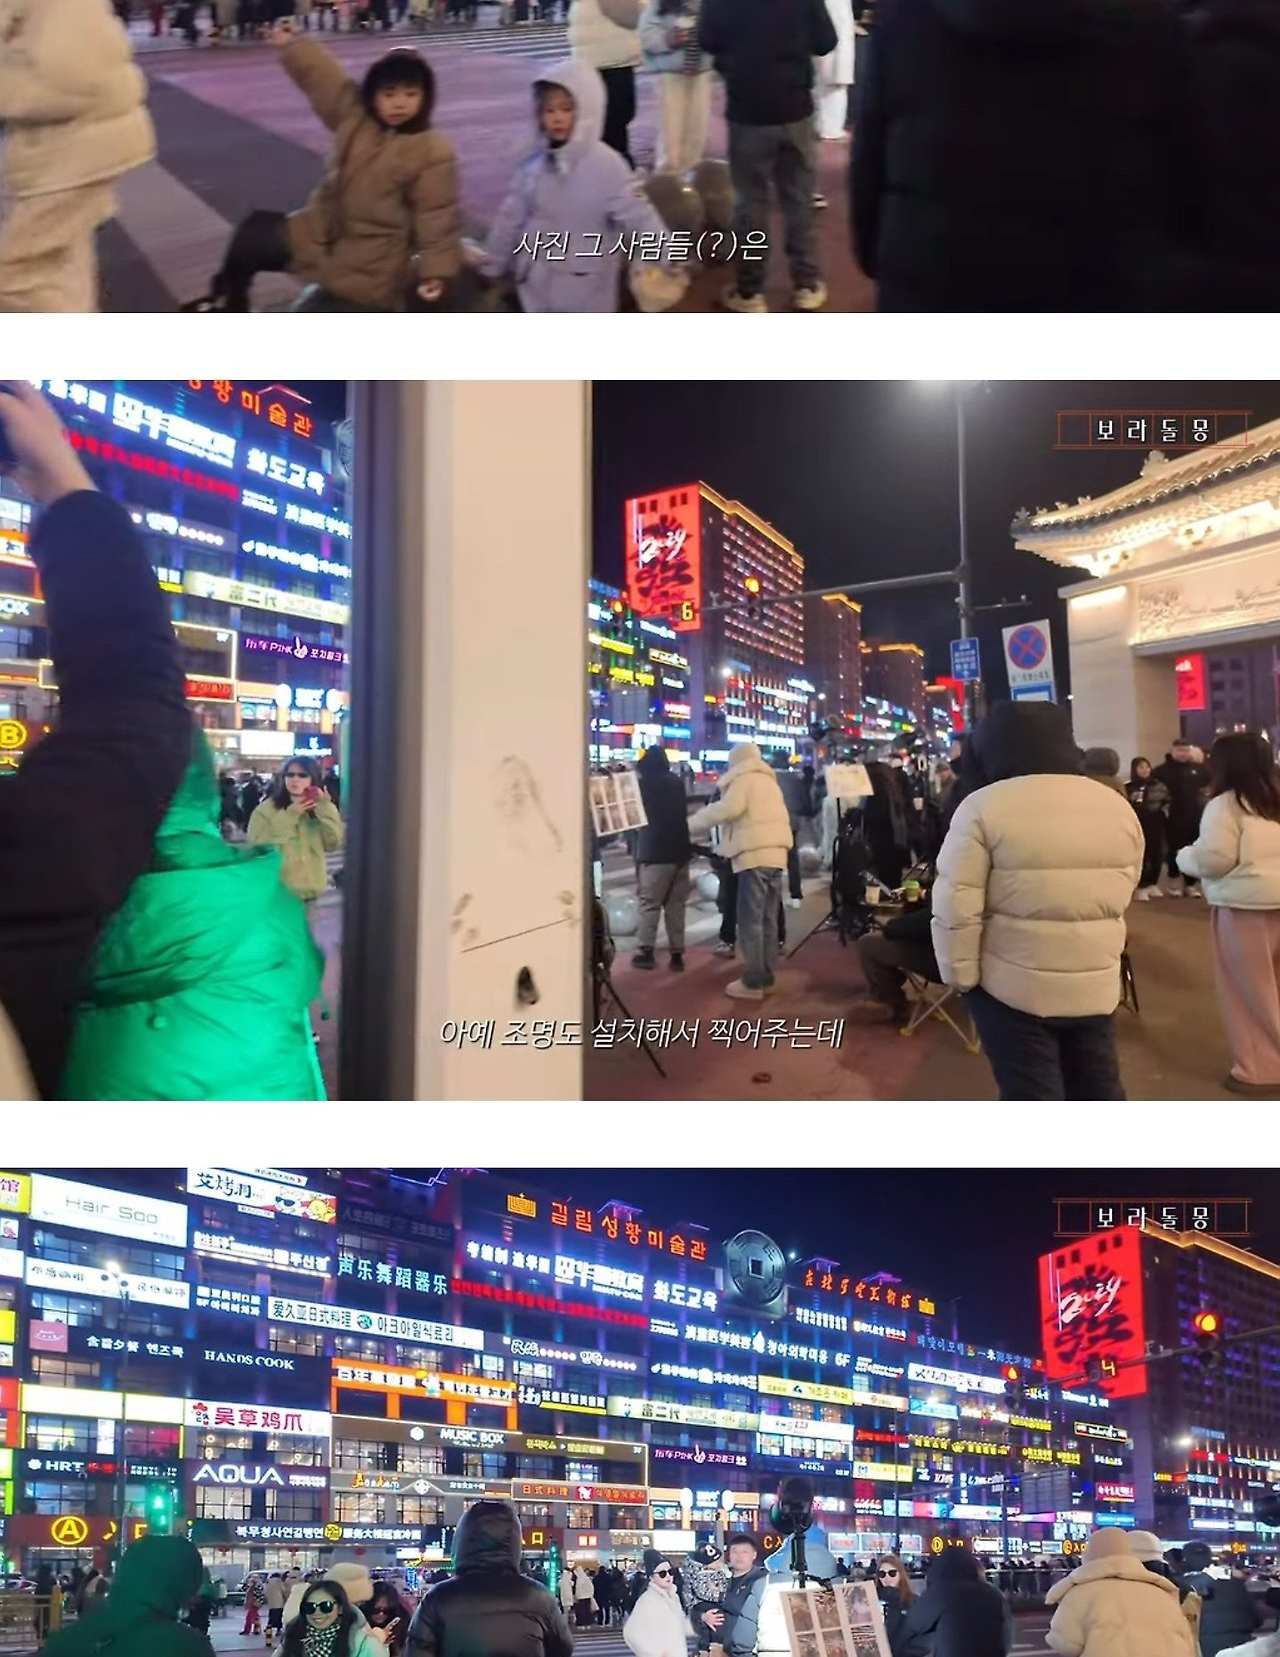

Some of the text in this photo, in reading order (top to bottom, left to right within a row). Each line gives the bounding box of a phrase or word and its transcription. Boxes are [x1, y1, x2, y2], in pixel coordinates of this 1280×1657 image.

[64, 1195, 158, 1226] Hair Soo
[337, 1254, 449, 1295] 声乐舞蹈器乐
[203, 1349, 295, 1371] HANDS COOK
[214, 1406, 304, 1432] 吴草鸡爪
[440, 1427, 505, 1445] MUSIC BOX
[45, 1459, 85, 1473] HRT
[193, 1463, 285, 1486] AQUA
